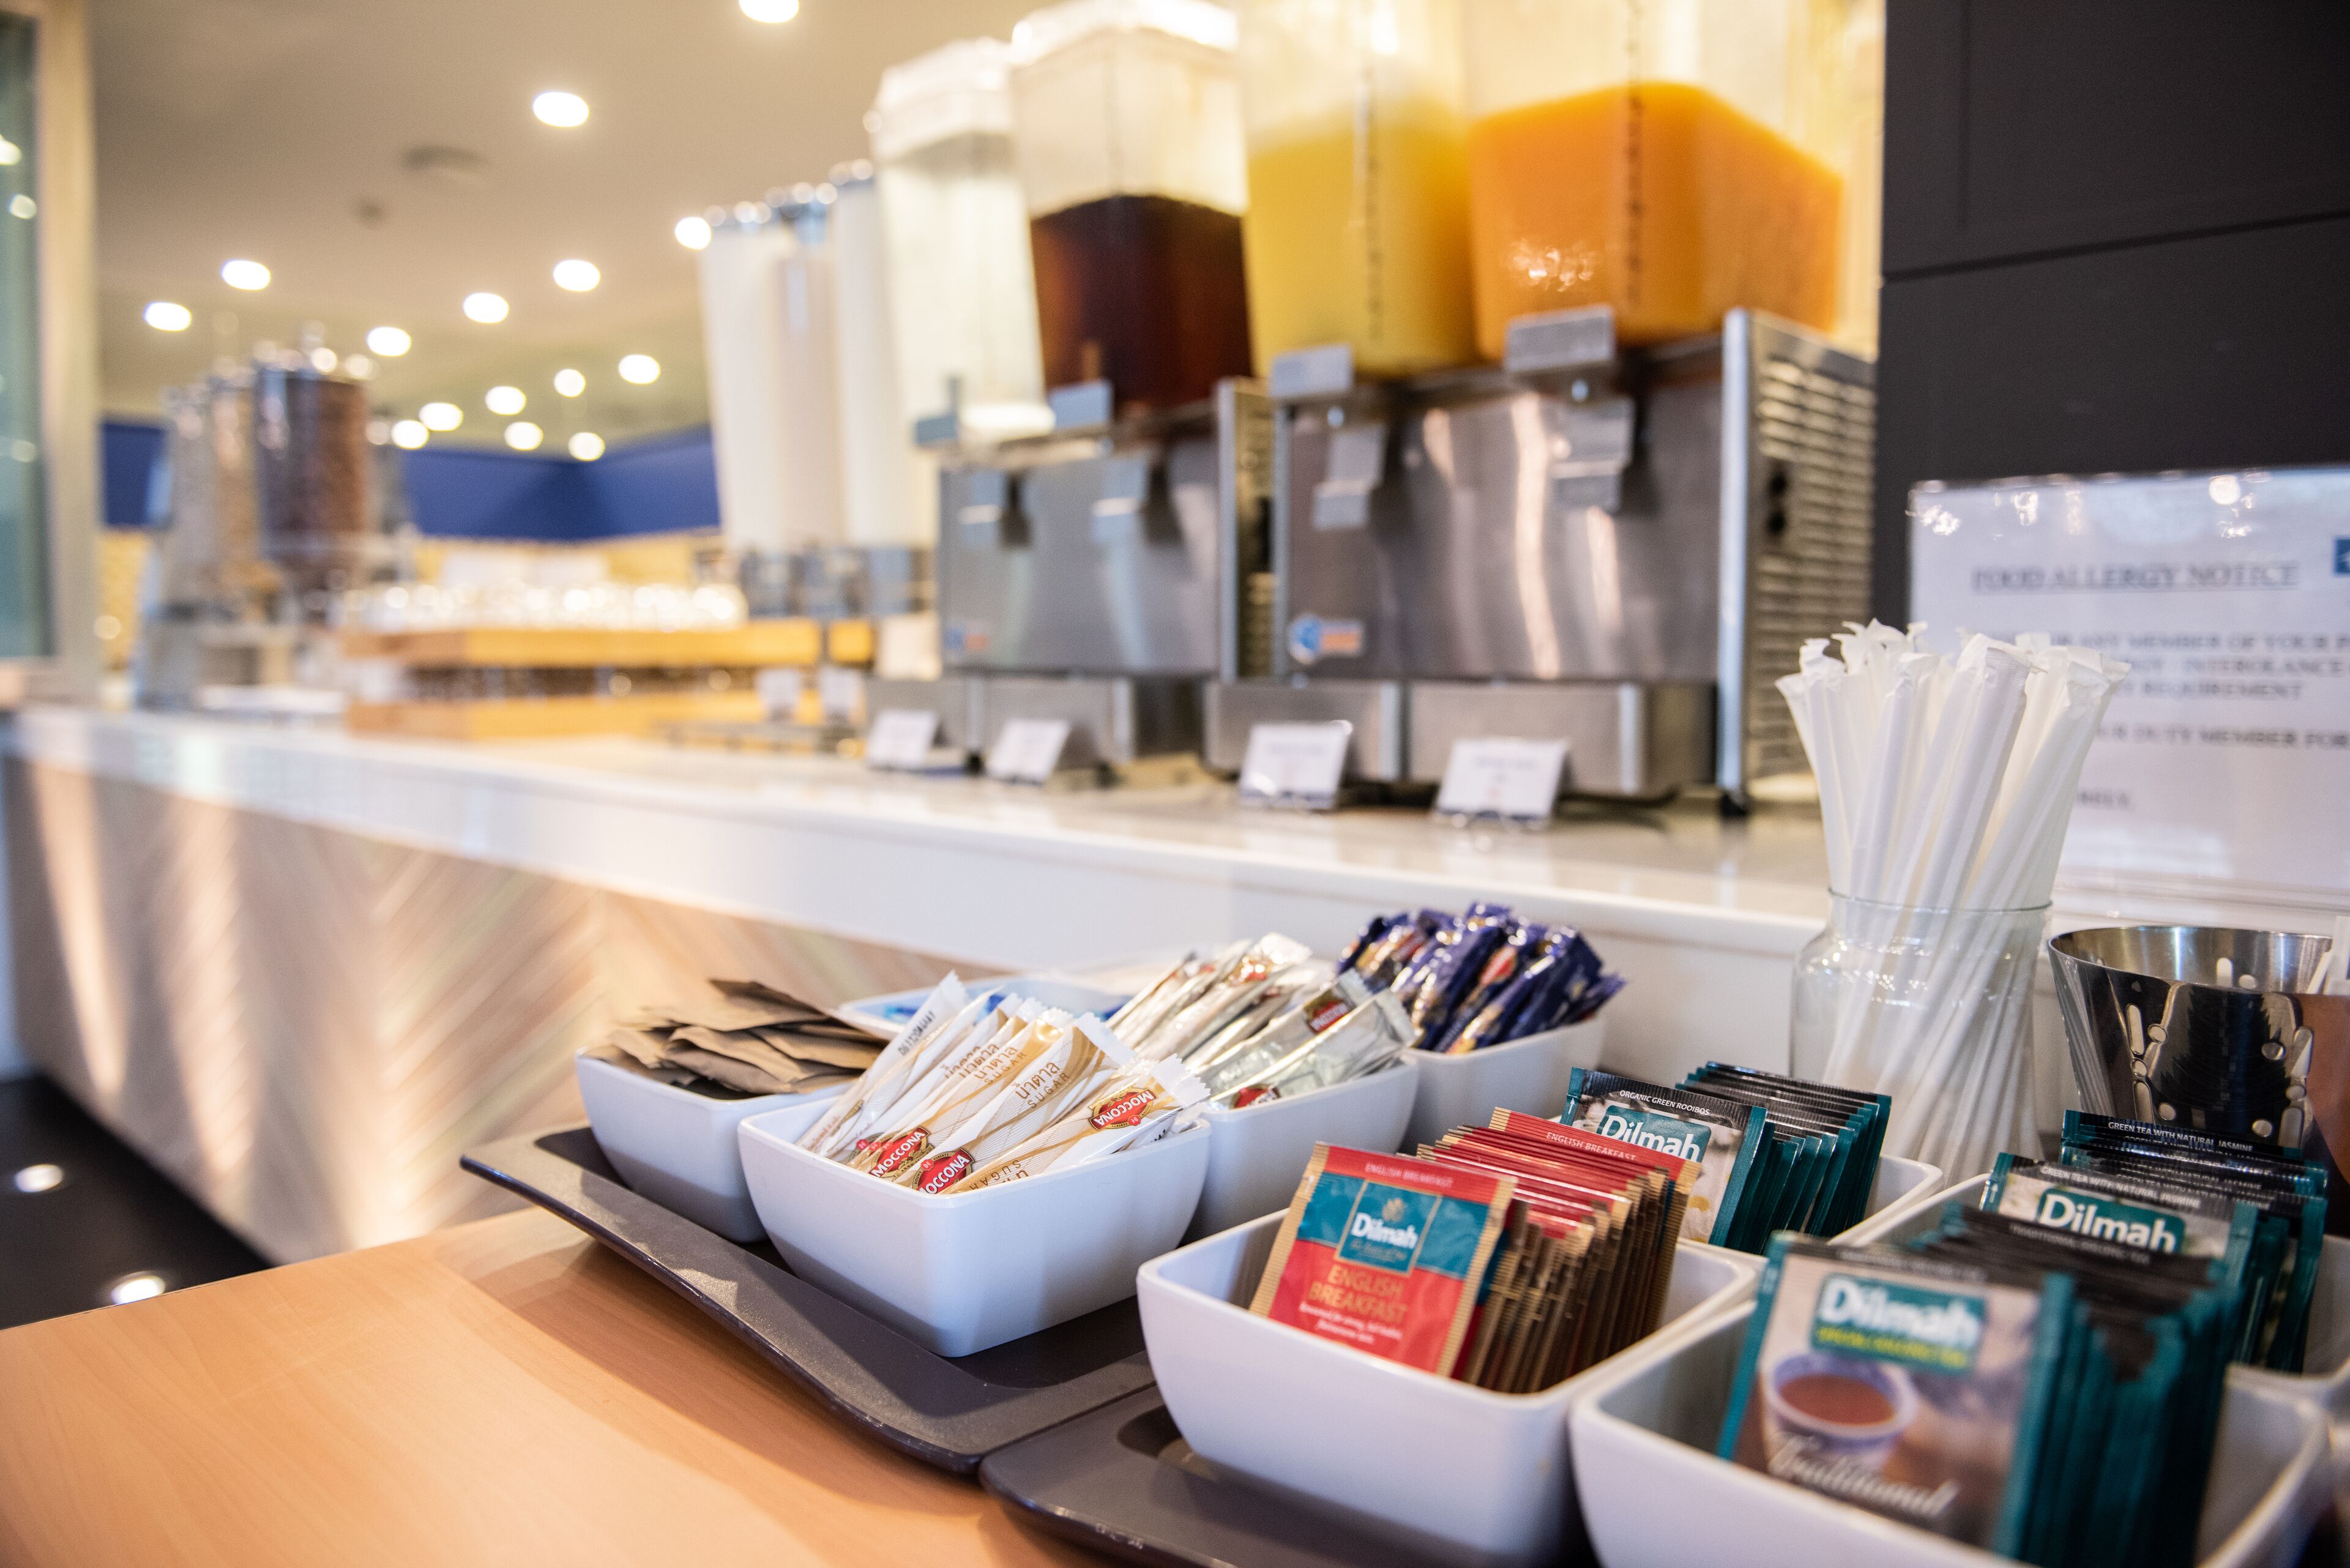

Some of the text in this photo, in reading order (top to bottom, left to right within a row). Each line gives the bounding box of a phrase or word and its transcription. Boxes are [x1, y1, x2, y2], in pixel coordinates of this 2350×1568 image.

[1972, 561, 2299, 588] FOOD ALLERGY NOTICE
[2128, 634, 2220, 651] MEMBER
[2141, 681, 2305, 699] REQUIREMENT
[2199, 728, 2298, 748] MEMBER
[1012, 1062, 1060, 1099] น้ำตาล
[1028, 1073, 1070, 1109] SUGAR
[1092, 1090, 1154, 1126] MOCCONA
[1619, 1090, 1710, 1116] ORGANIC GREEN ROOIBOS
[870, 1131, 926, 1178] MOCCONA
[1546, 1132, 1636, 1161] ENGLISH BREAKFAST
[1601, 1115, 1700, 1162] Dilmah
[2108, 1121, 2135, 1133] GREEN
[2136, 1126, 2152, 1135] TEA
[2153, 1129, 2175, 1139] WITH
[2176, 1133, 2214, 1146] NATURAL
[2218, 1140, 2254, 1152] JASMINE
[1365, 1163, 1402, 1178] ENGLISH
[2039, 1165, 2070, 1180] GREEN
[2071, 1173, 2088, 1184] TEA
[2089, 1176, 2113, 1189] WITH
[2115, 1182, 2158, 1199] NATURAL
[2159, 1193, 2201, 1209] JASMINE
[1351, 1212, 1419, 1249] Dilmah
[2039, 1194, 2177, 1253] Dilmah
[1327, 1264, 1404, 1299] ENGLISH
[1308, 1281, 1407, 1324] BREAKFAST
[1822, 1278, 1980, 1350] Dilmah
